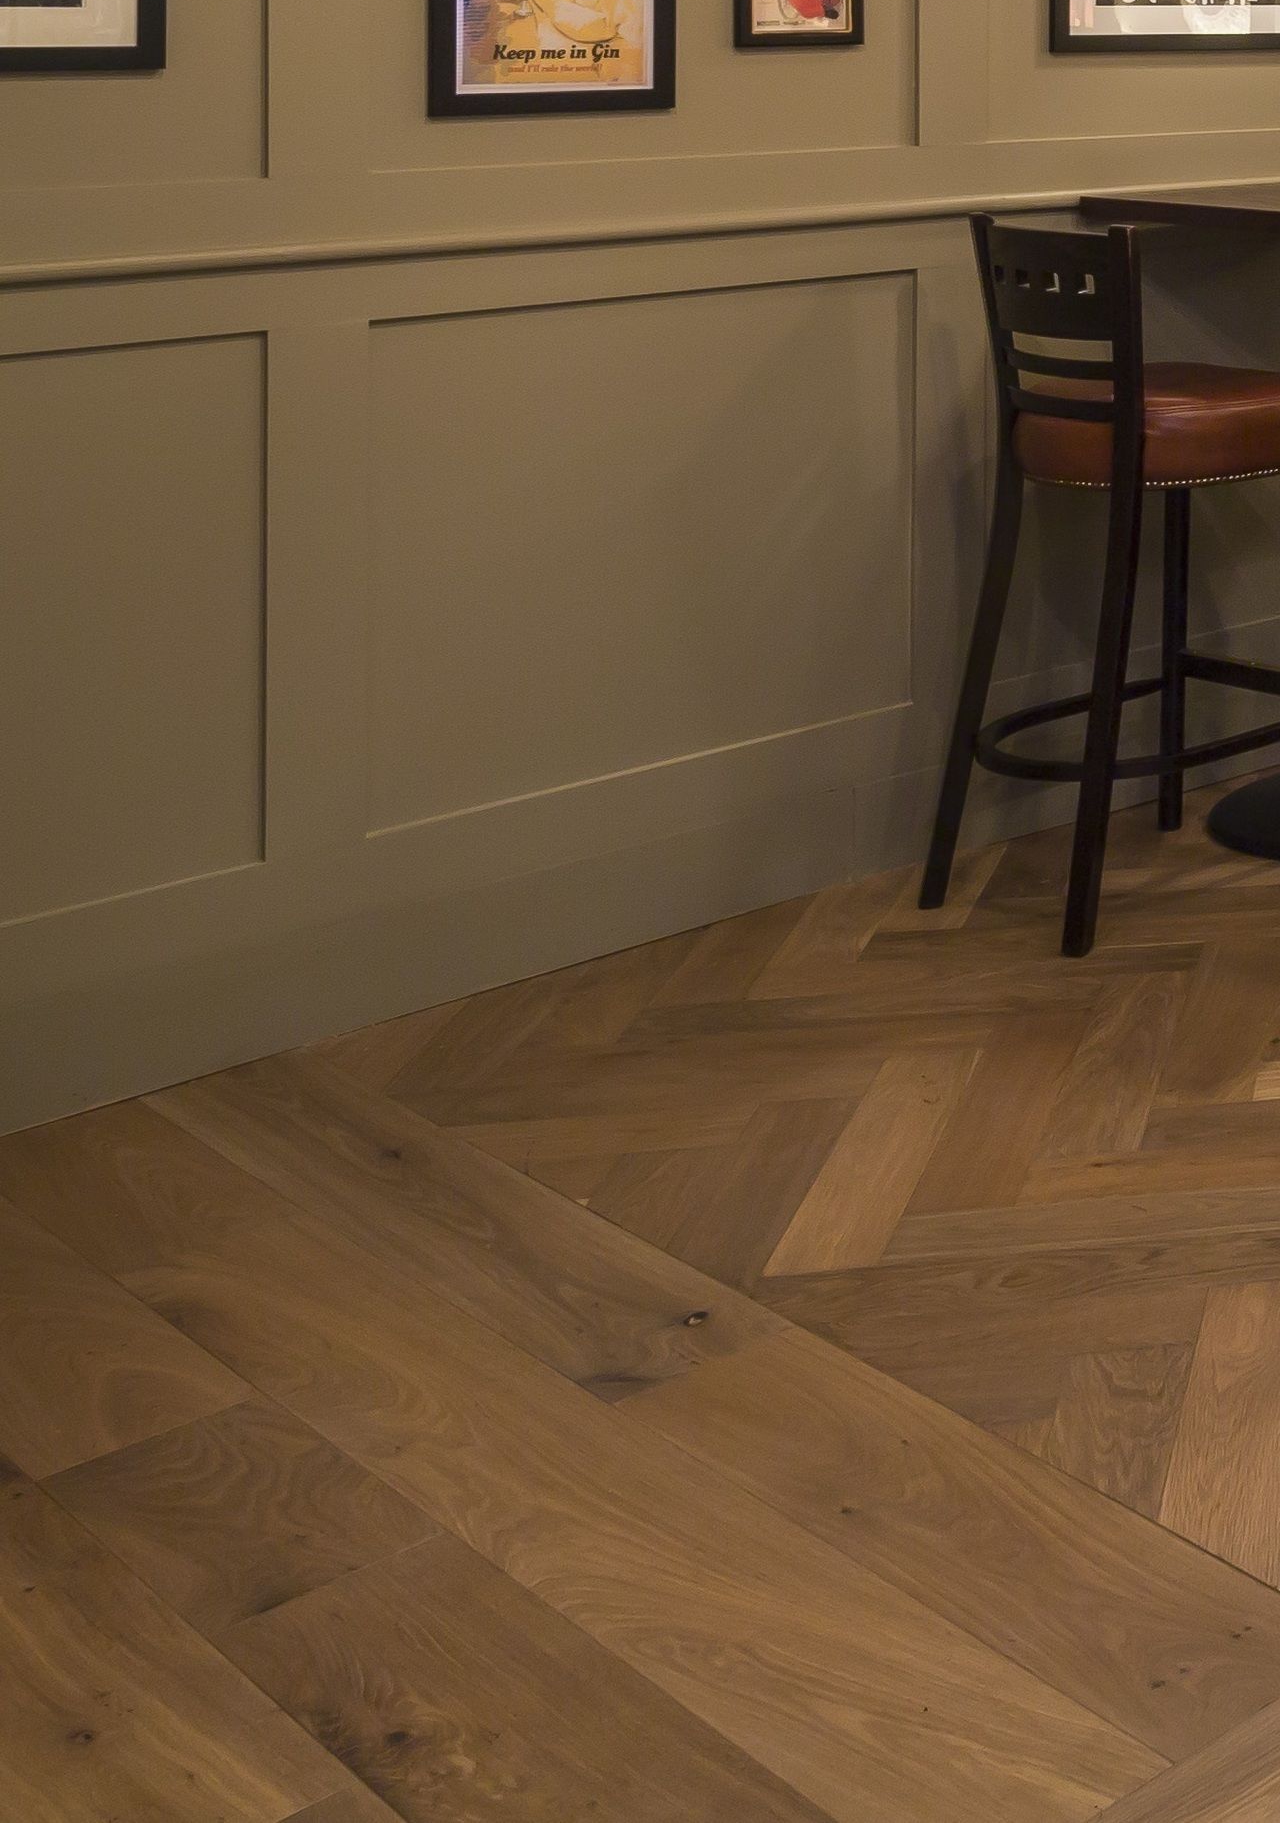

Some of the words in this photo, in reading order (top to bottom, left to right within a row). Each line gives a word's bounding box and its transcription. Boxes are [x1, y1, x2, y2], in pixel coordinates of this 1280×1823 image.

[493, 44, 536, 63] Keep
[540, 49, 568, 60] me
[569, 45, 587, 59] in
[591, 44, 620, 63] Gin
